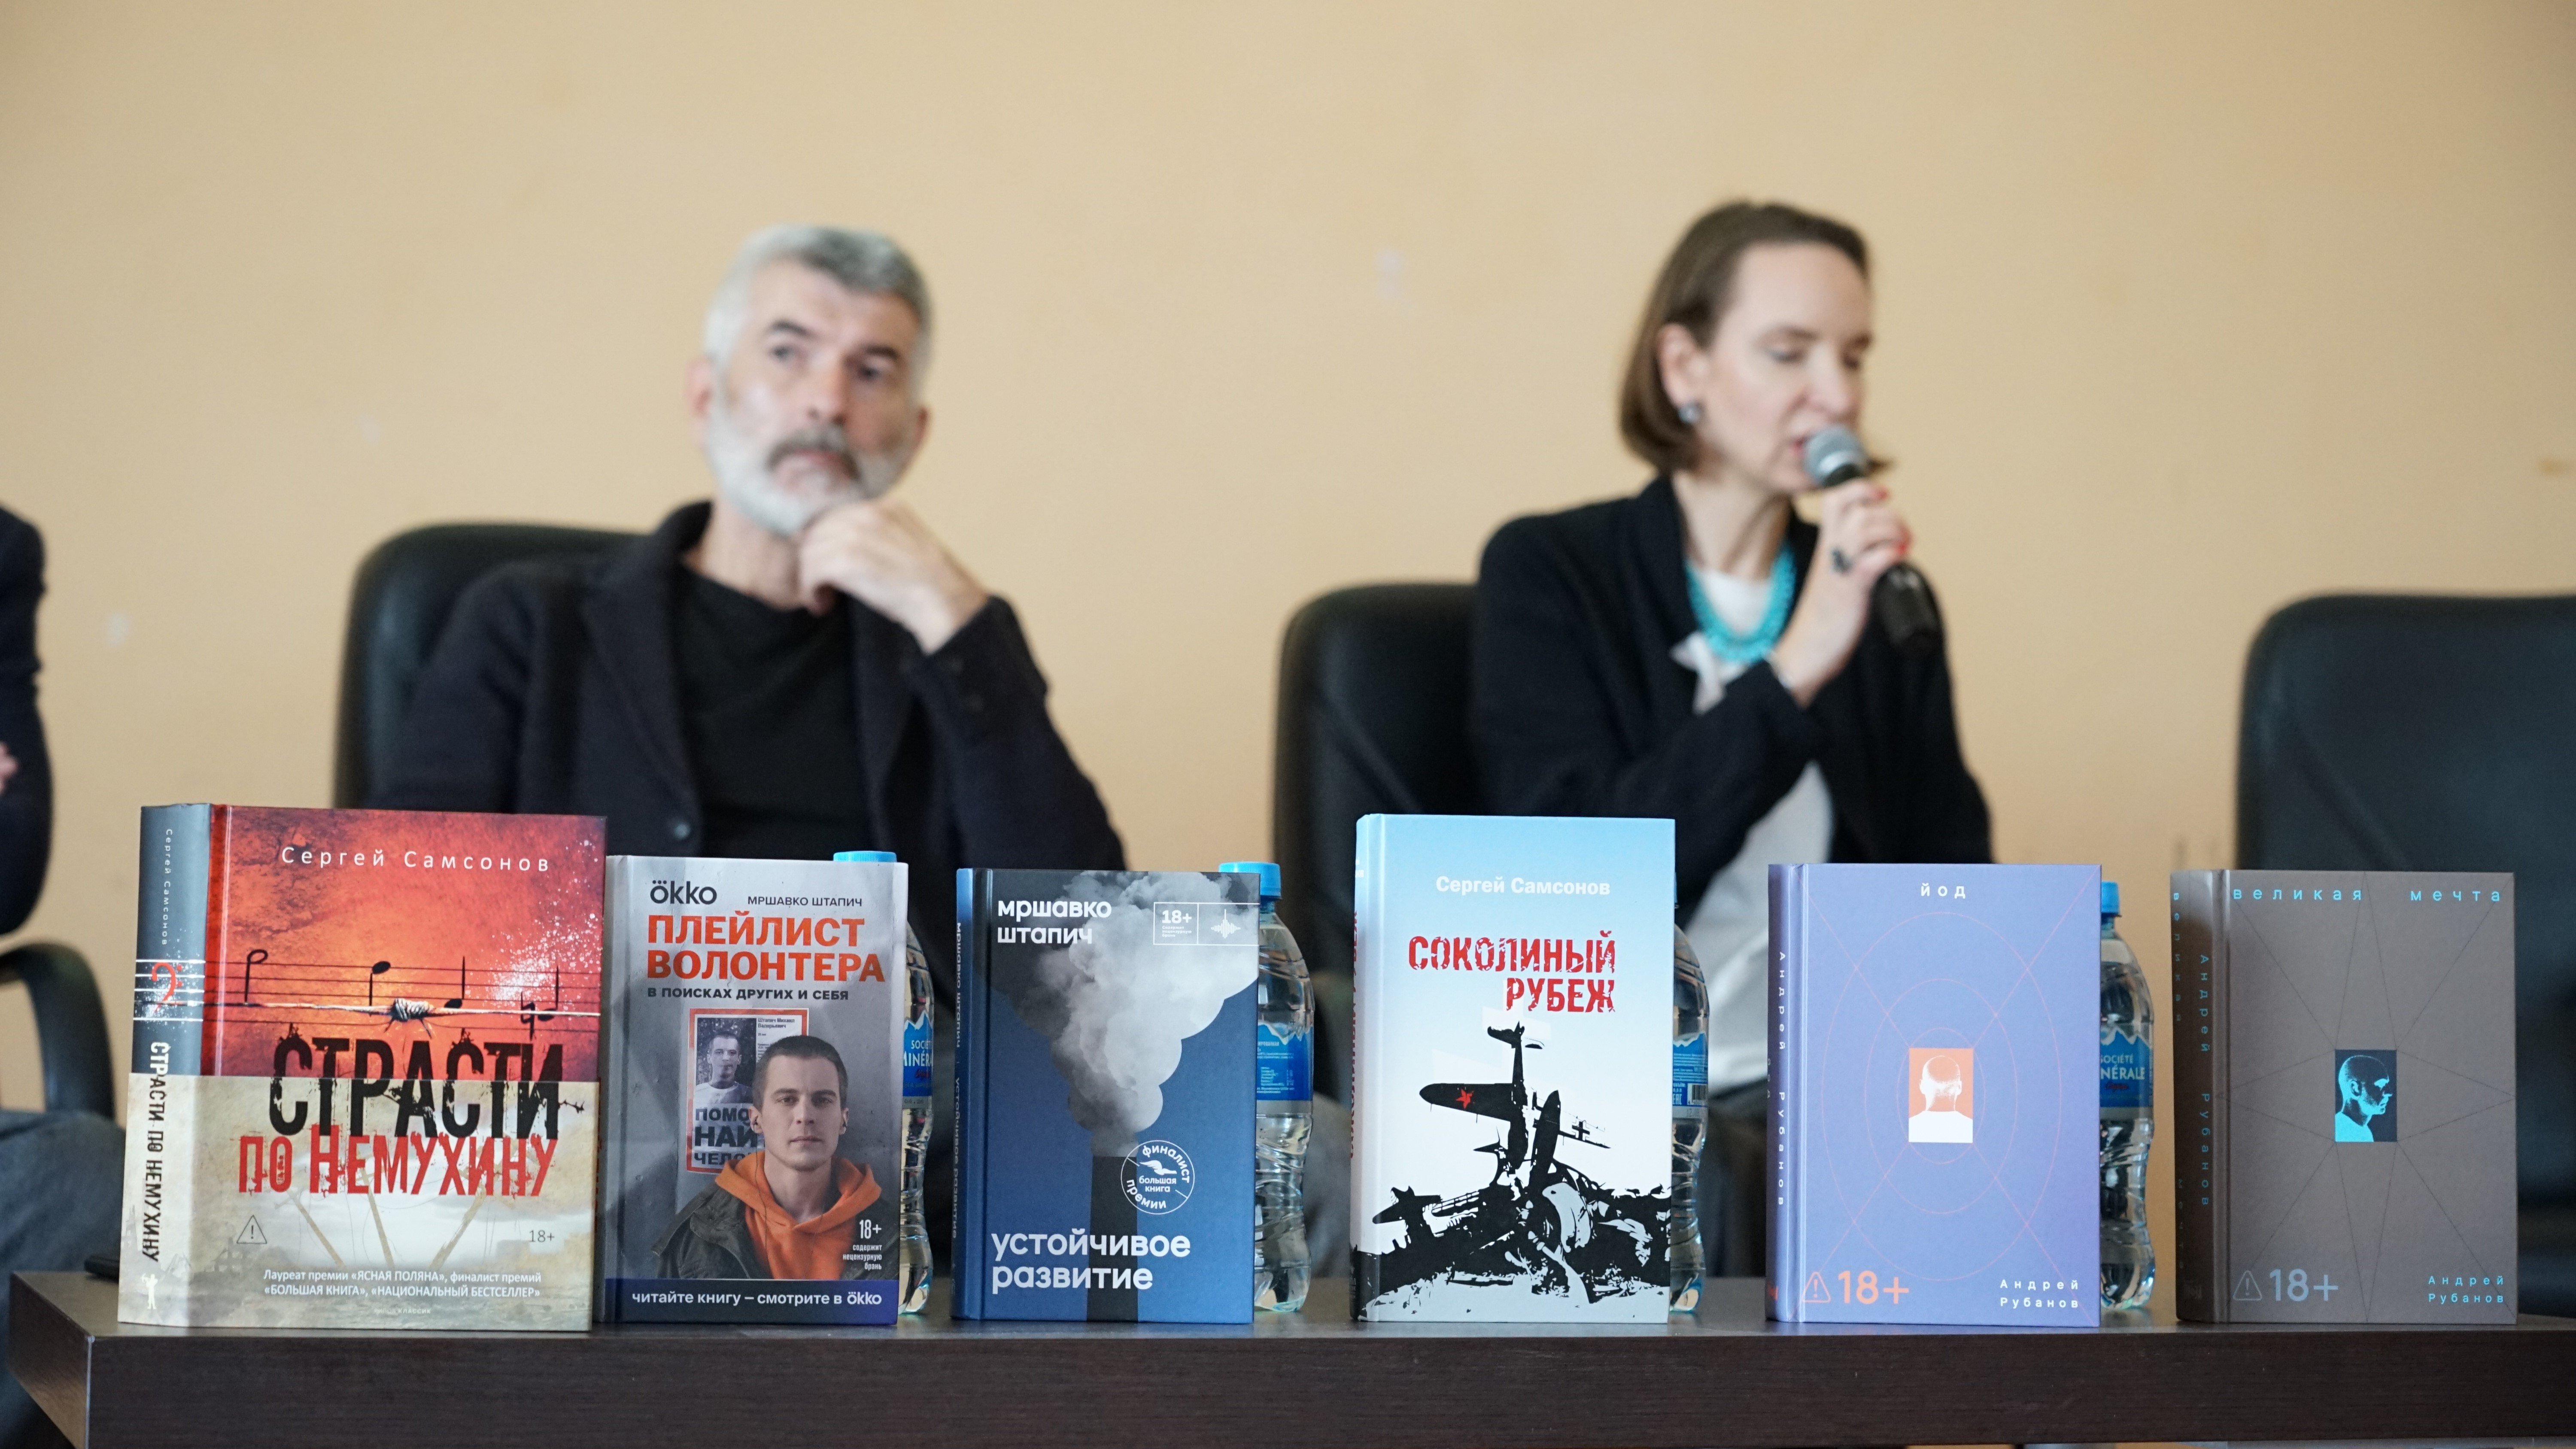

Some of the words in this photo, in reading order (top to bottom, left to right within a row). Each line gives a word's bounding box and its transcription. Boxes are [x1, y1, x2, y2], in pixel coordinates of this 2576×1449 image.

[282, 847, 385, 868] Сергей
[404, 851, 550, 872] Самсонов
[1436, 876, 1504, 896] Сергей
[1511, 877, 1610, 895] Самсонов
[2233, 889, 2361, 901] великая
[2411, 890, 2500, 902] мечта
[748, 896, 808, 906] МРШАВКО
[812, 897, 862, 907] ШТАПИЧ
[998, 900, 1112, 922] мршавко
[161, 881, 170, 946] Самсонов
[1162, 910, 1192, 923] 18+
[648, 910, 865, 947] ПЛЕЙЛИСТ
[997, 928, 1092, 944] штапич
[1409, 930, 1616, 973] СОКОЛИНЫЙ
[647, 950, 885, 982] ВОЛОНТЕРА
[648, 988, 656, 998] В
[662, 988, 732, 999] ПОИСКАХ
[736, 989, 793, 1001] ДРУГИХ
[799, 990, 808, 1000] И
[813, 990, 848, 1001] СЕБЯ
[1507, 978, 1616, 1013] РУБЕЖ
[2200, 955, 2210, 1052] Андрей
[149, 1042, 169, 1121] СТРАСТИ
[269, 1035, 562, 1140] СТРАСТИ
[147, 1130, 164, 1153] ПО
[2200, 1093, 2210, 1205] Рубанов
[1142, 1145, 1190, 1183] финалист
[1139, 1176, 1176, 1184] большая
[1127, 1179, 1166, 1209] премии
[142, 1159, 164, 1263] НЕМУХИНУ
[529, 1230, 555, 1242] 18+
[860, 1219, 881, 1239] 18+
[991, 1229, 1191, 1261] устойчивое
[264, 1270, 306, 1282] Лауреат
[309, 1271, 348, 1282] премии
[352, 1271, 392, 1281] «ЯСНАЯ
[395, 1271, 447, 1283] ПОЛЯНА»,
[450, 1271, 498, 1283] финалист
[502, 1272, 541, 1284] премий
[865, 1262, 882, 1271] брань
[992, 1265, 1153, 1294] развитие
[1838, 1270, 1909, 1304] 18+
[2000, 1279, 2078, 1291] Андрей
[2269, 1269, 2338, 1301] 18+
[2428, 1275, 2504, 1287] Андрей
[264, 1285, 322, 1295] «БОЛЬШАЯ
[326, 1285, 368, 1297] КНИГА»,
[372, 1285, 468, 1297] «НАЦИОНАЛЬНЫЙ
[471, 1287, 540, 1297] БЕСТСЕЛЛЕР»
[632, 1291, 694, 1304] читайте
[698, 1293, 741, 1306] книгу
[757, 1293, 829, 1306] смотрите
[834, 1295, 842, 1304] в
[2428, 1293, 2504, 1304] Рубанов
[2000, 1297, 2078, 1310] Рубанов
